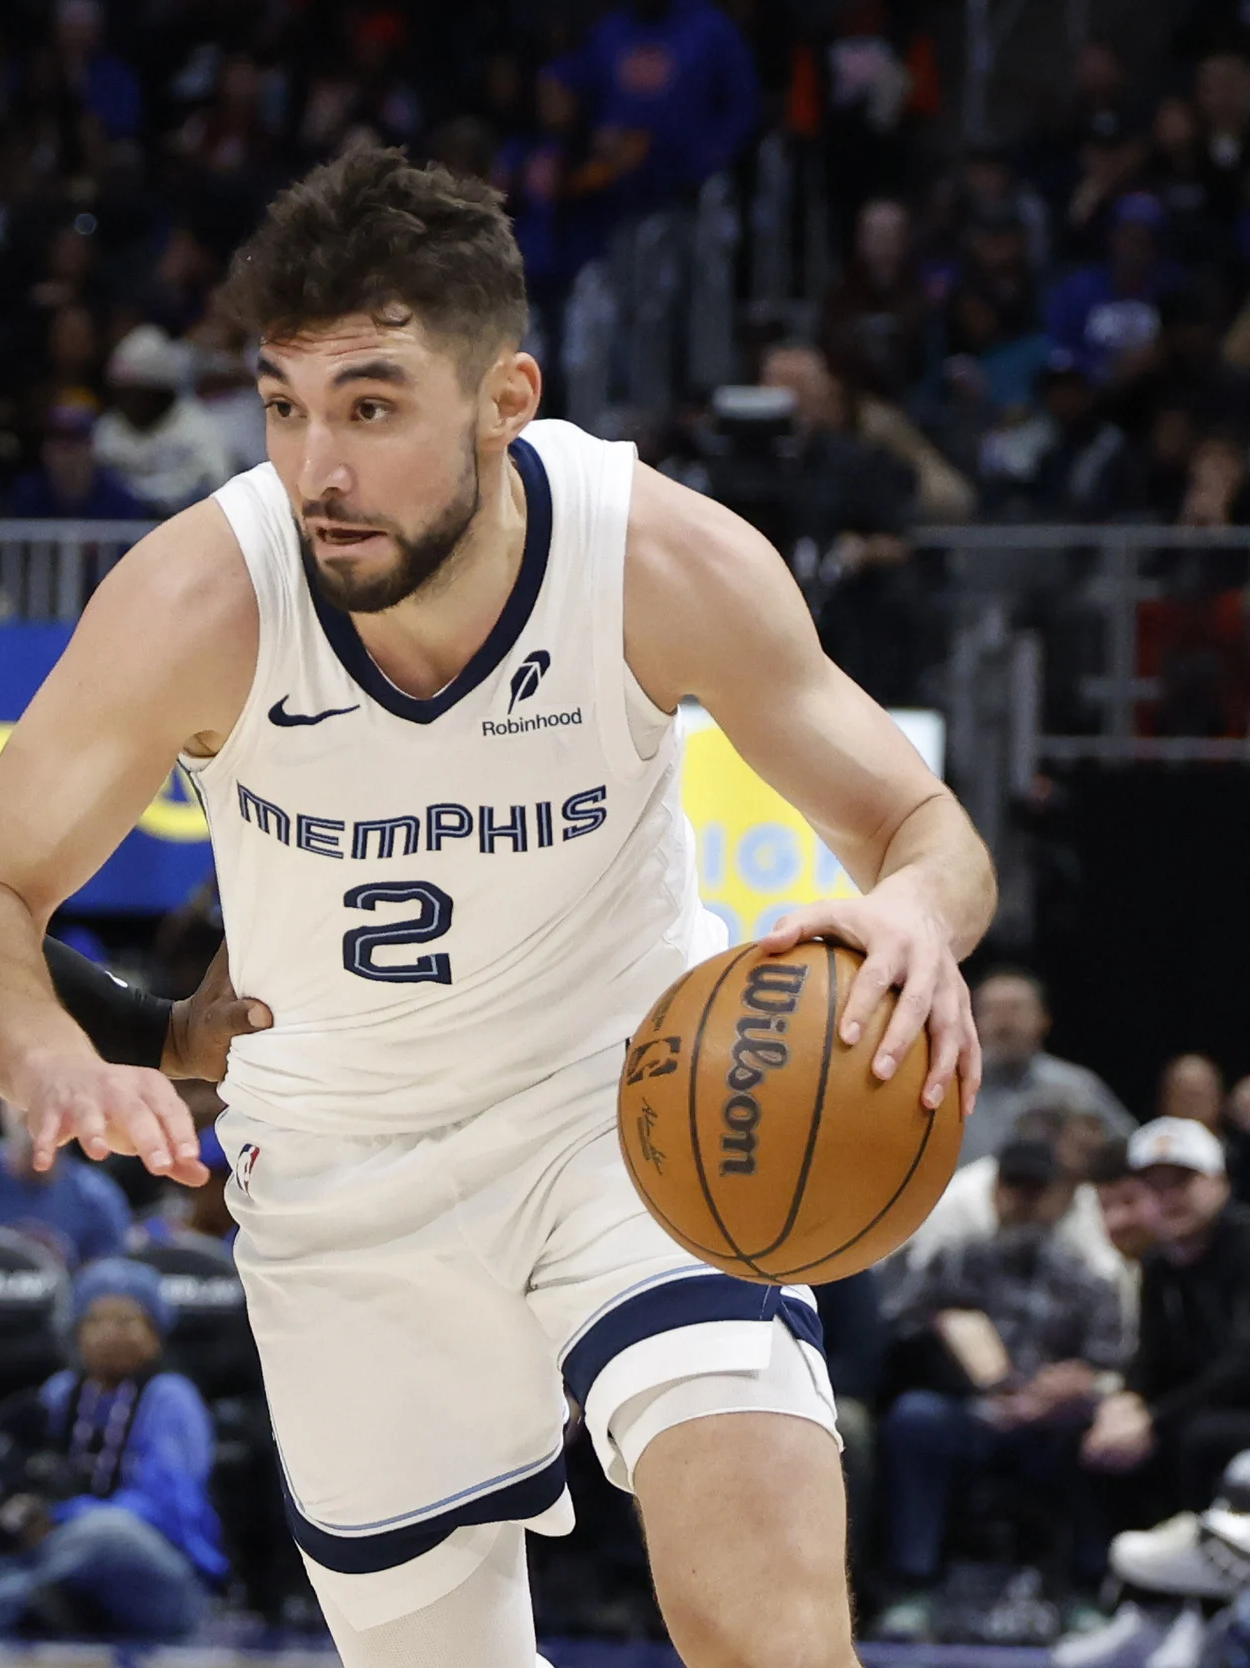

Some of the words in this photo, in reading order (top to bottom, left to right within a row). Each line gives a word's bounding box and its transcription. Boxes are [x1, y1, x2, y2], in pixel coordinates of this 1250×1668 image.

[482, 707, 582, 737] Robinhood
[236, 780, 607, 860] MEMPHIS
[342, 880, 454, 985] 2
[718, 963, 809, 1178] Wilson
